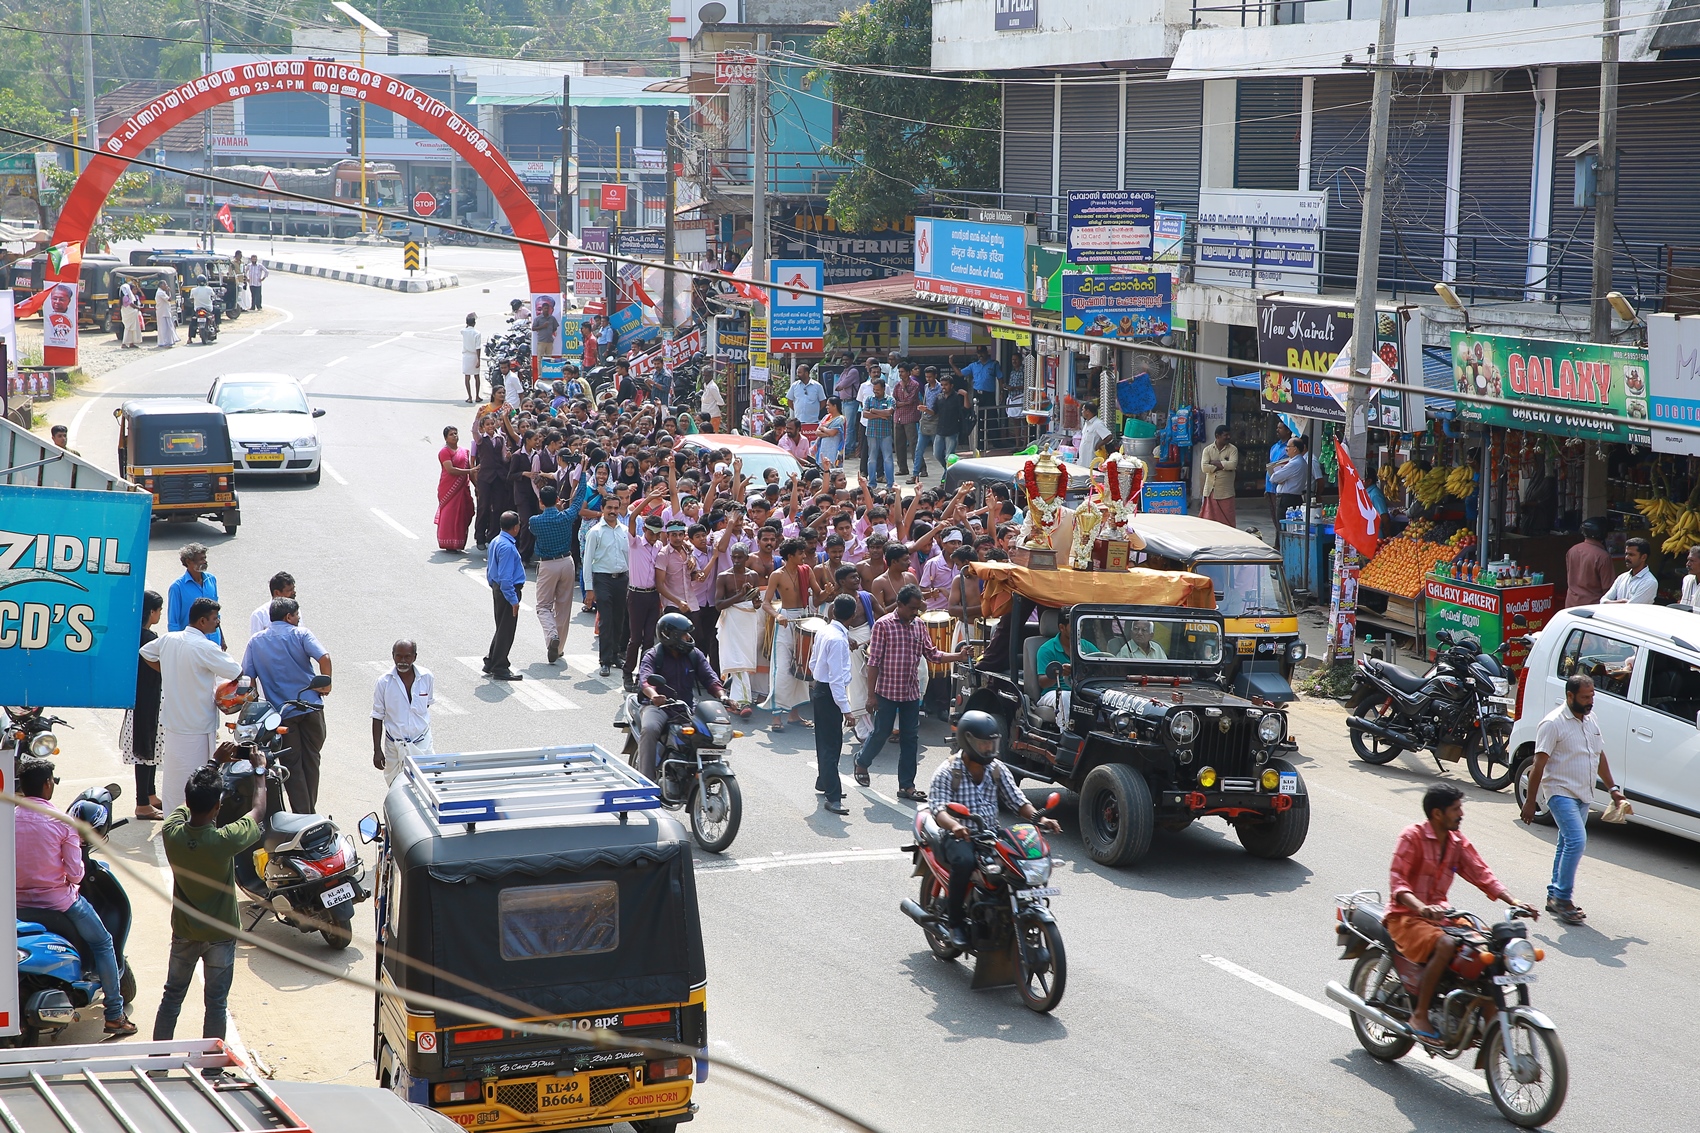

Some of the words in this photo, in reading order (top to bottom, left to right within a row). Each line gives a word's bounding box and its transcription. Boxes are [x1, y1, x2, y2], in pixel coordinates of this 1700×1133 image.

[314, 64, 382, 88] നവകേരള
[217, 137, 248, 146] YAMAHA
[1070, 192, 1100, 201] പ്രവാസി
[1102, 192, 1128, 200] സേവന
[416, 200, 434, 208] STOP
[585, 242, 604, 250] ATM
[576, 270, 602, 280] STUDIO
[950, 262, 968, 274] Central
[969, 265, 982, 276] Bank
[984, 267, 990, 277] of
[990, 268, 1004, 279] India
[916, 280, 930, 290] ATM
[1262, 304, 1286, 339] New
[1287, 311, 1335, 341] Kairali
[1508, 352, 1612, 406] GALAXY
[1297, 380, 1312, 393] Hot
[1314, 381, 1321, 395] &
[1428, 582, 1461, 602] GALAXY
[1462, 591, 1497, 612] BAKERY
[1189, 624, 1210, 632] LION
[628, 1093, 653, 1105] SOUND
[656, 1091, 678, 1102] HORN
[477, 1110, 499, 1124] SIGNAL
